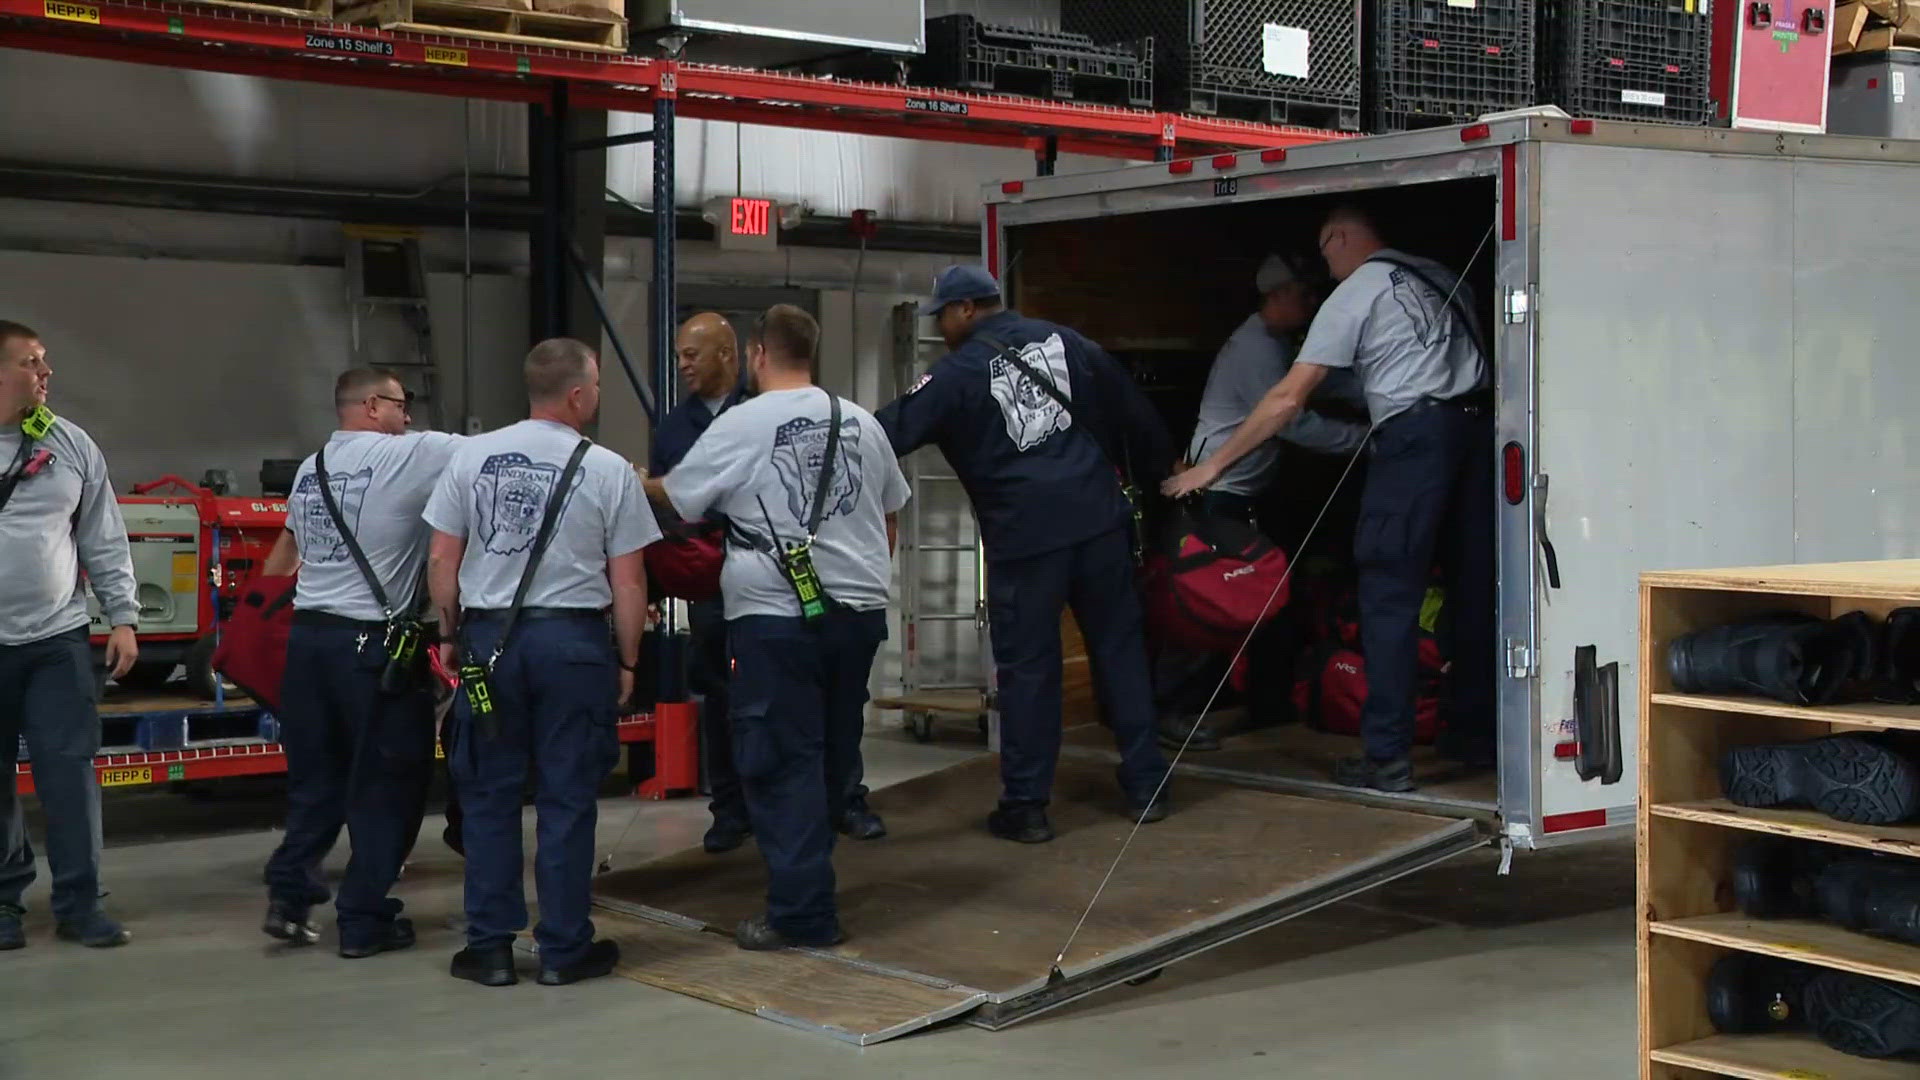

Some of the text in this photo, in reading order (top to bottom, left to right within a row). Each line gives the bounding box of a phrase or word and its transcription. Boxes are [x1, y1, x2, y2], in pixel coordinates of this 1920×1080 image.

[46, 2, 98, 20] HEPP 9
[306, 35, 393, 55] Zone 15 Shelf 3
[426, 48, 458, 61] HEPP
[905, 98, 968, 114] Zone 16 Shelf 3
[731, 198, 770, 236] EXIT
[500, 468, 551, 483] INDIANA
[497, 523, 535, 536] IN-TF
[104, 769, 150, 784] HEPP 6
